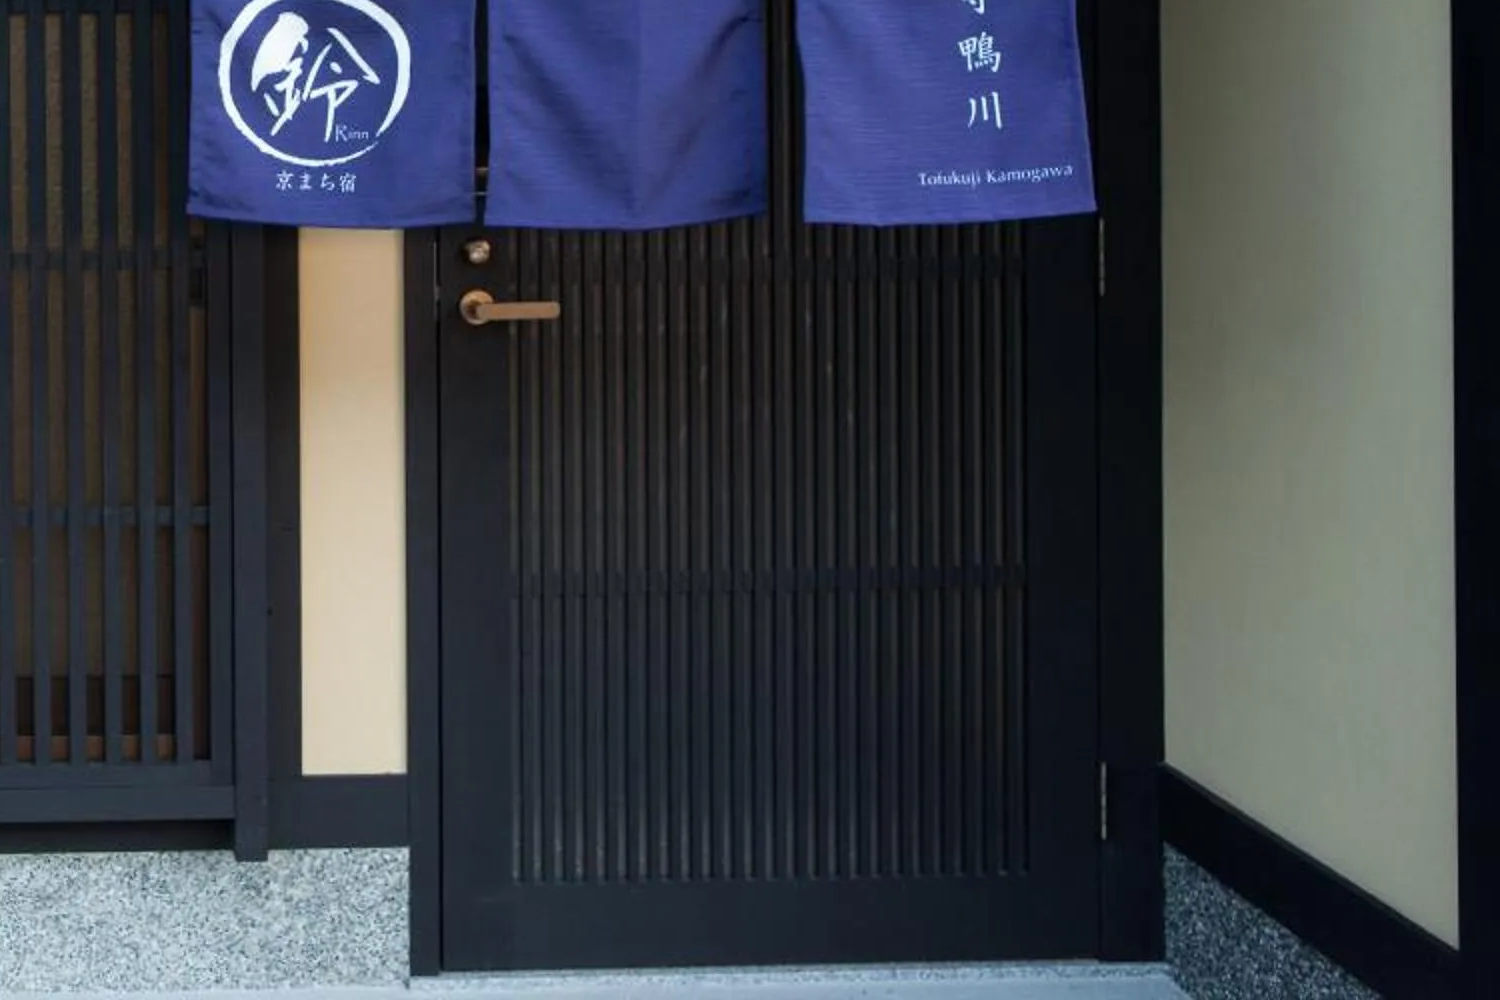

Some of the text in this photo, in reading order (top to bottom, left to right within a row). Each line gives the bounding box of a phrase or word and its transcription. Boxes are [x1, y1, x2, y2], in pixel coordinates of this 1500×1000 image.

[275, 170, 357, 193] 京まち宿
[986, 164, 1074, 184] Kamogawa
